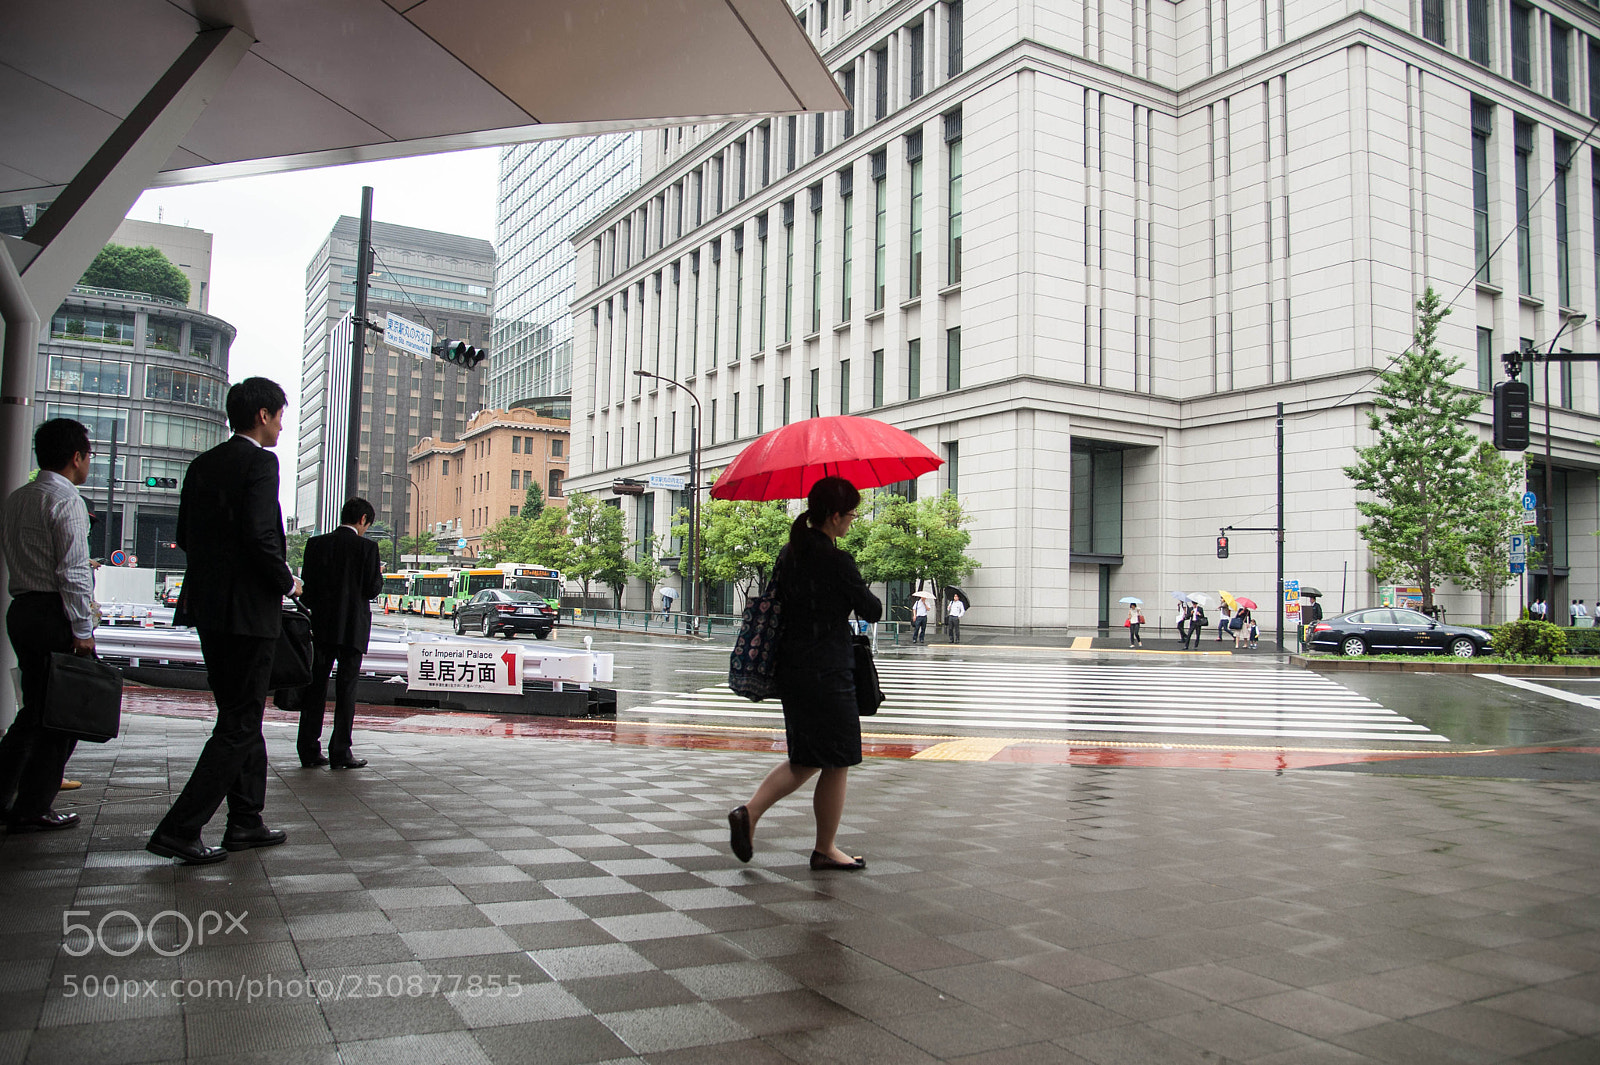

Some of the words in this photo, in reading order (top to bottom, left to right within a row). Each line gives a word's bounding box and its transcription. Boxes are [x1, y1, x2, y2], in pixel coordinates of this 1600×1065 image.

[1513, 537, 1521, 552] P
[422, 648, 432, 656] for
[434, 649, 464, 658] Imperial
[467, 650, 493, 659] Palace
[418, 660, 496, 683] 皇居方面
